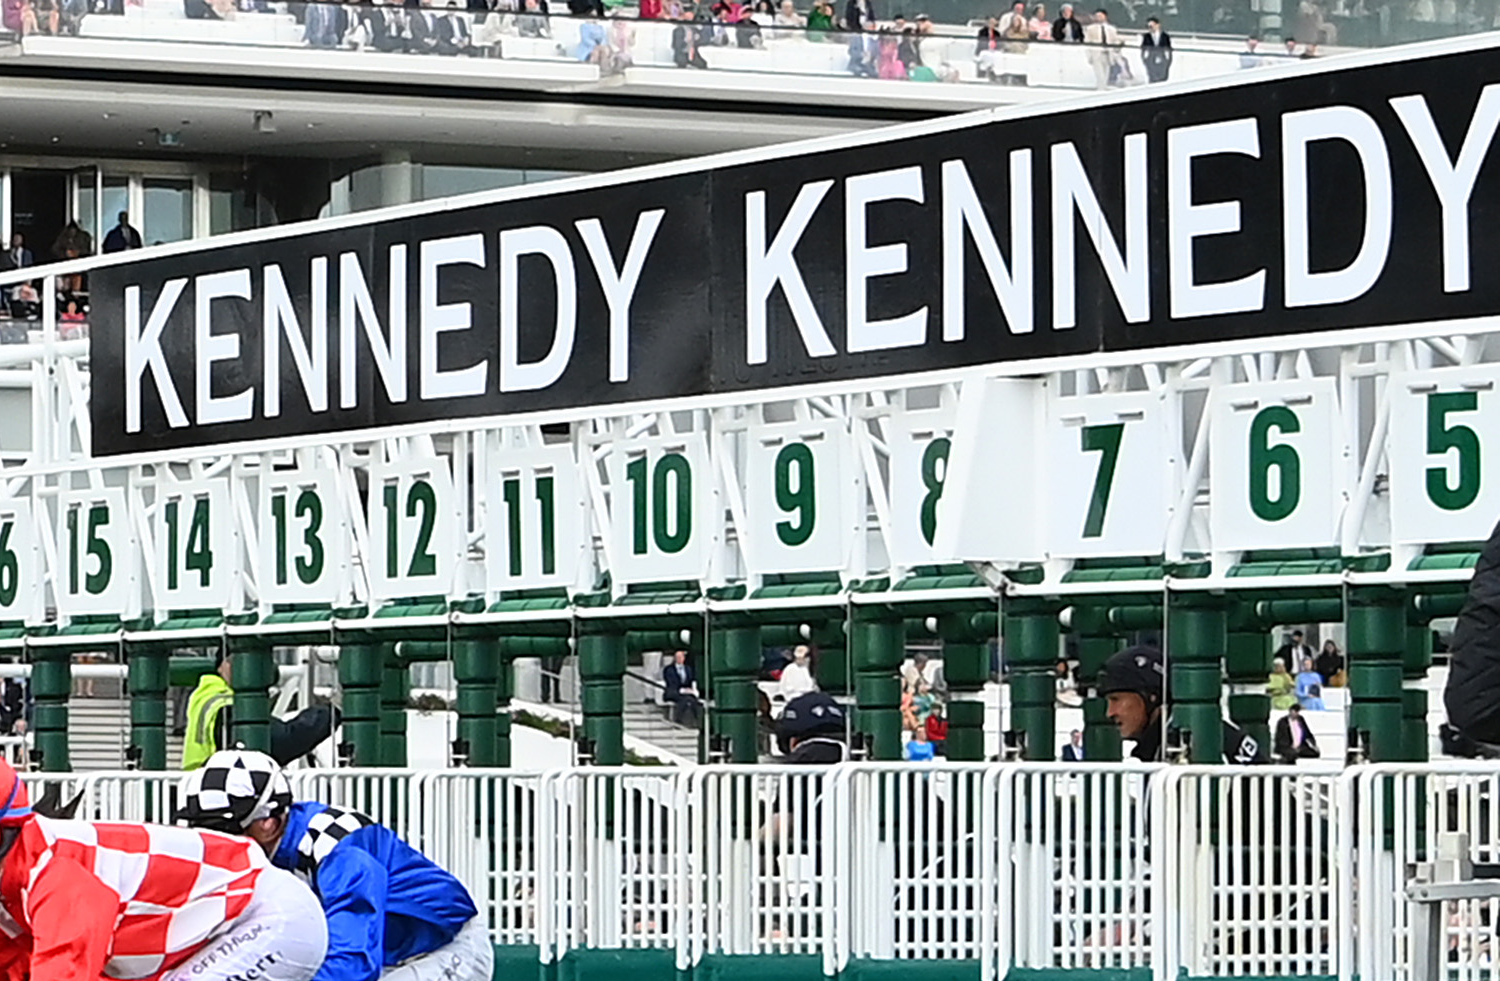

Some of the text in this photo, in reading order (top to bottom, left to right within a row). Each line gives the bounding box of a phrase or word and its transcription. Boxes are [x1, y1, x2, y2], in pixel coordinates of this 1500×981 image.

[125, 83, 1500, 433] KENNEDY KENNEDY
[774, 442, 817, 547] 9
[1080, 423, 1125, 538] 7
[1248, 405, 1301, 522] 6
[1425, 391, 1483, 512] 5
[66, 506, 113, 596] 15
[164, 497, 213, 590] 14
[271, 489, 325, 585] 13
[382, 480, 437, 578] 12
[503, 476, 556, 577] 11
[625, 452, 693, 555] 10
